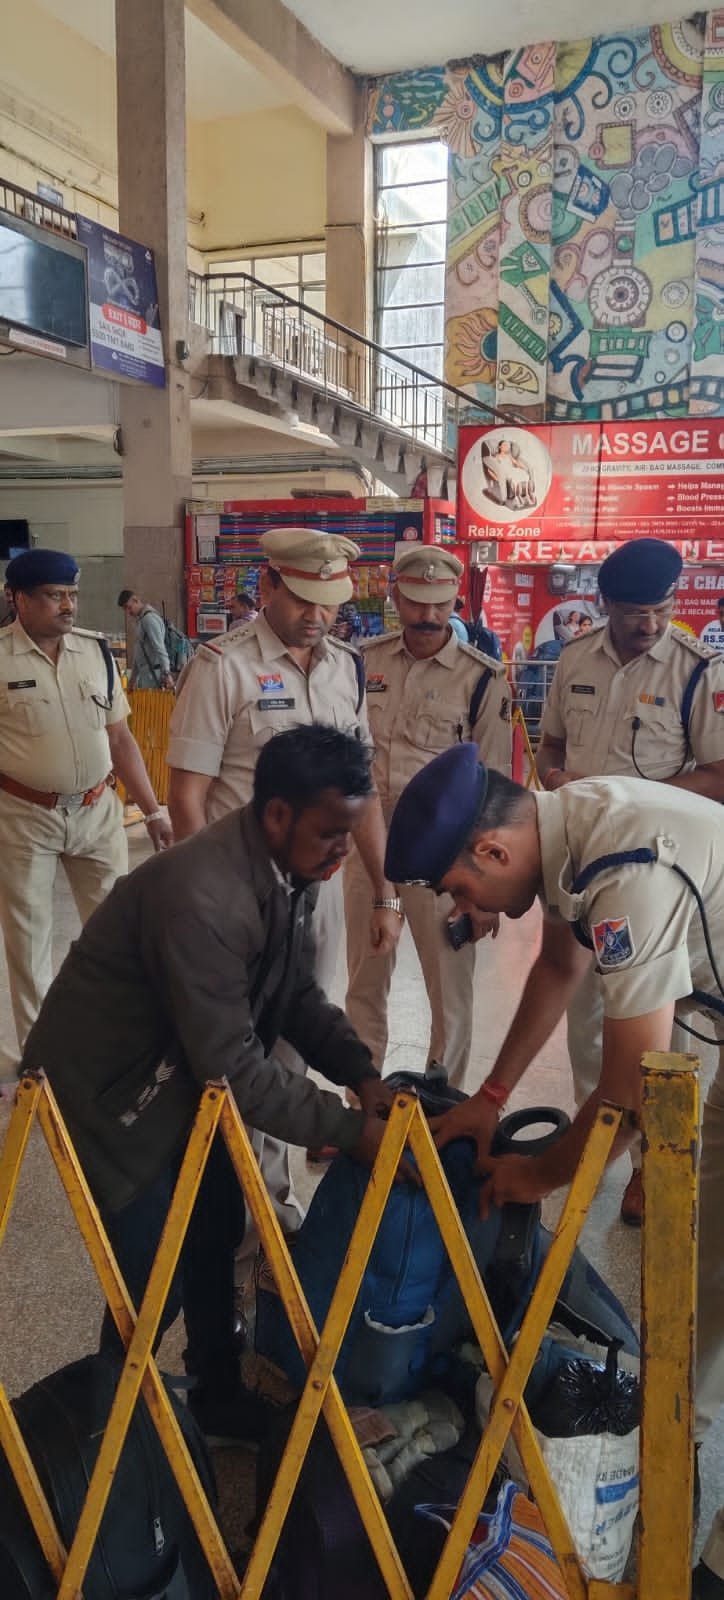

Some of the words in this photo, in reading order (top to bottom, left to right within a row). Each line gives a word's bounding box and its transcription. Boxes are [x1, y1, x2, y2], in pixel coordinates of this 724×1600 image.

[572, 430, 709, 455] MASSAGE
[677, 482, 699, 492] Helps
[677, 493, 699, 503] Blood
[676, 503, 702, 513] Boosts
[468, 525, 503, 538] Relax
[507, 525, 541, 538] Zone
